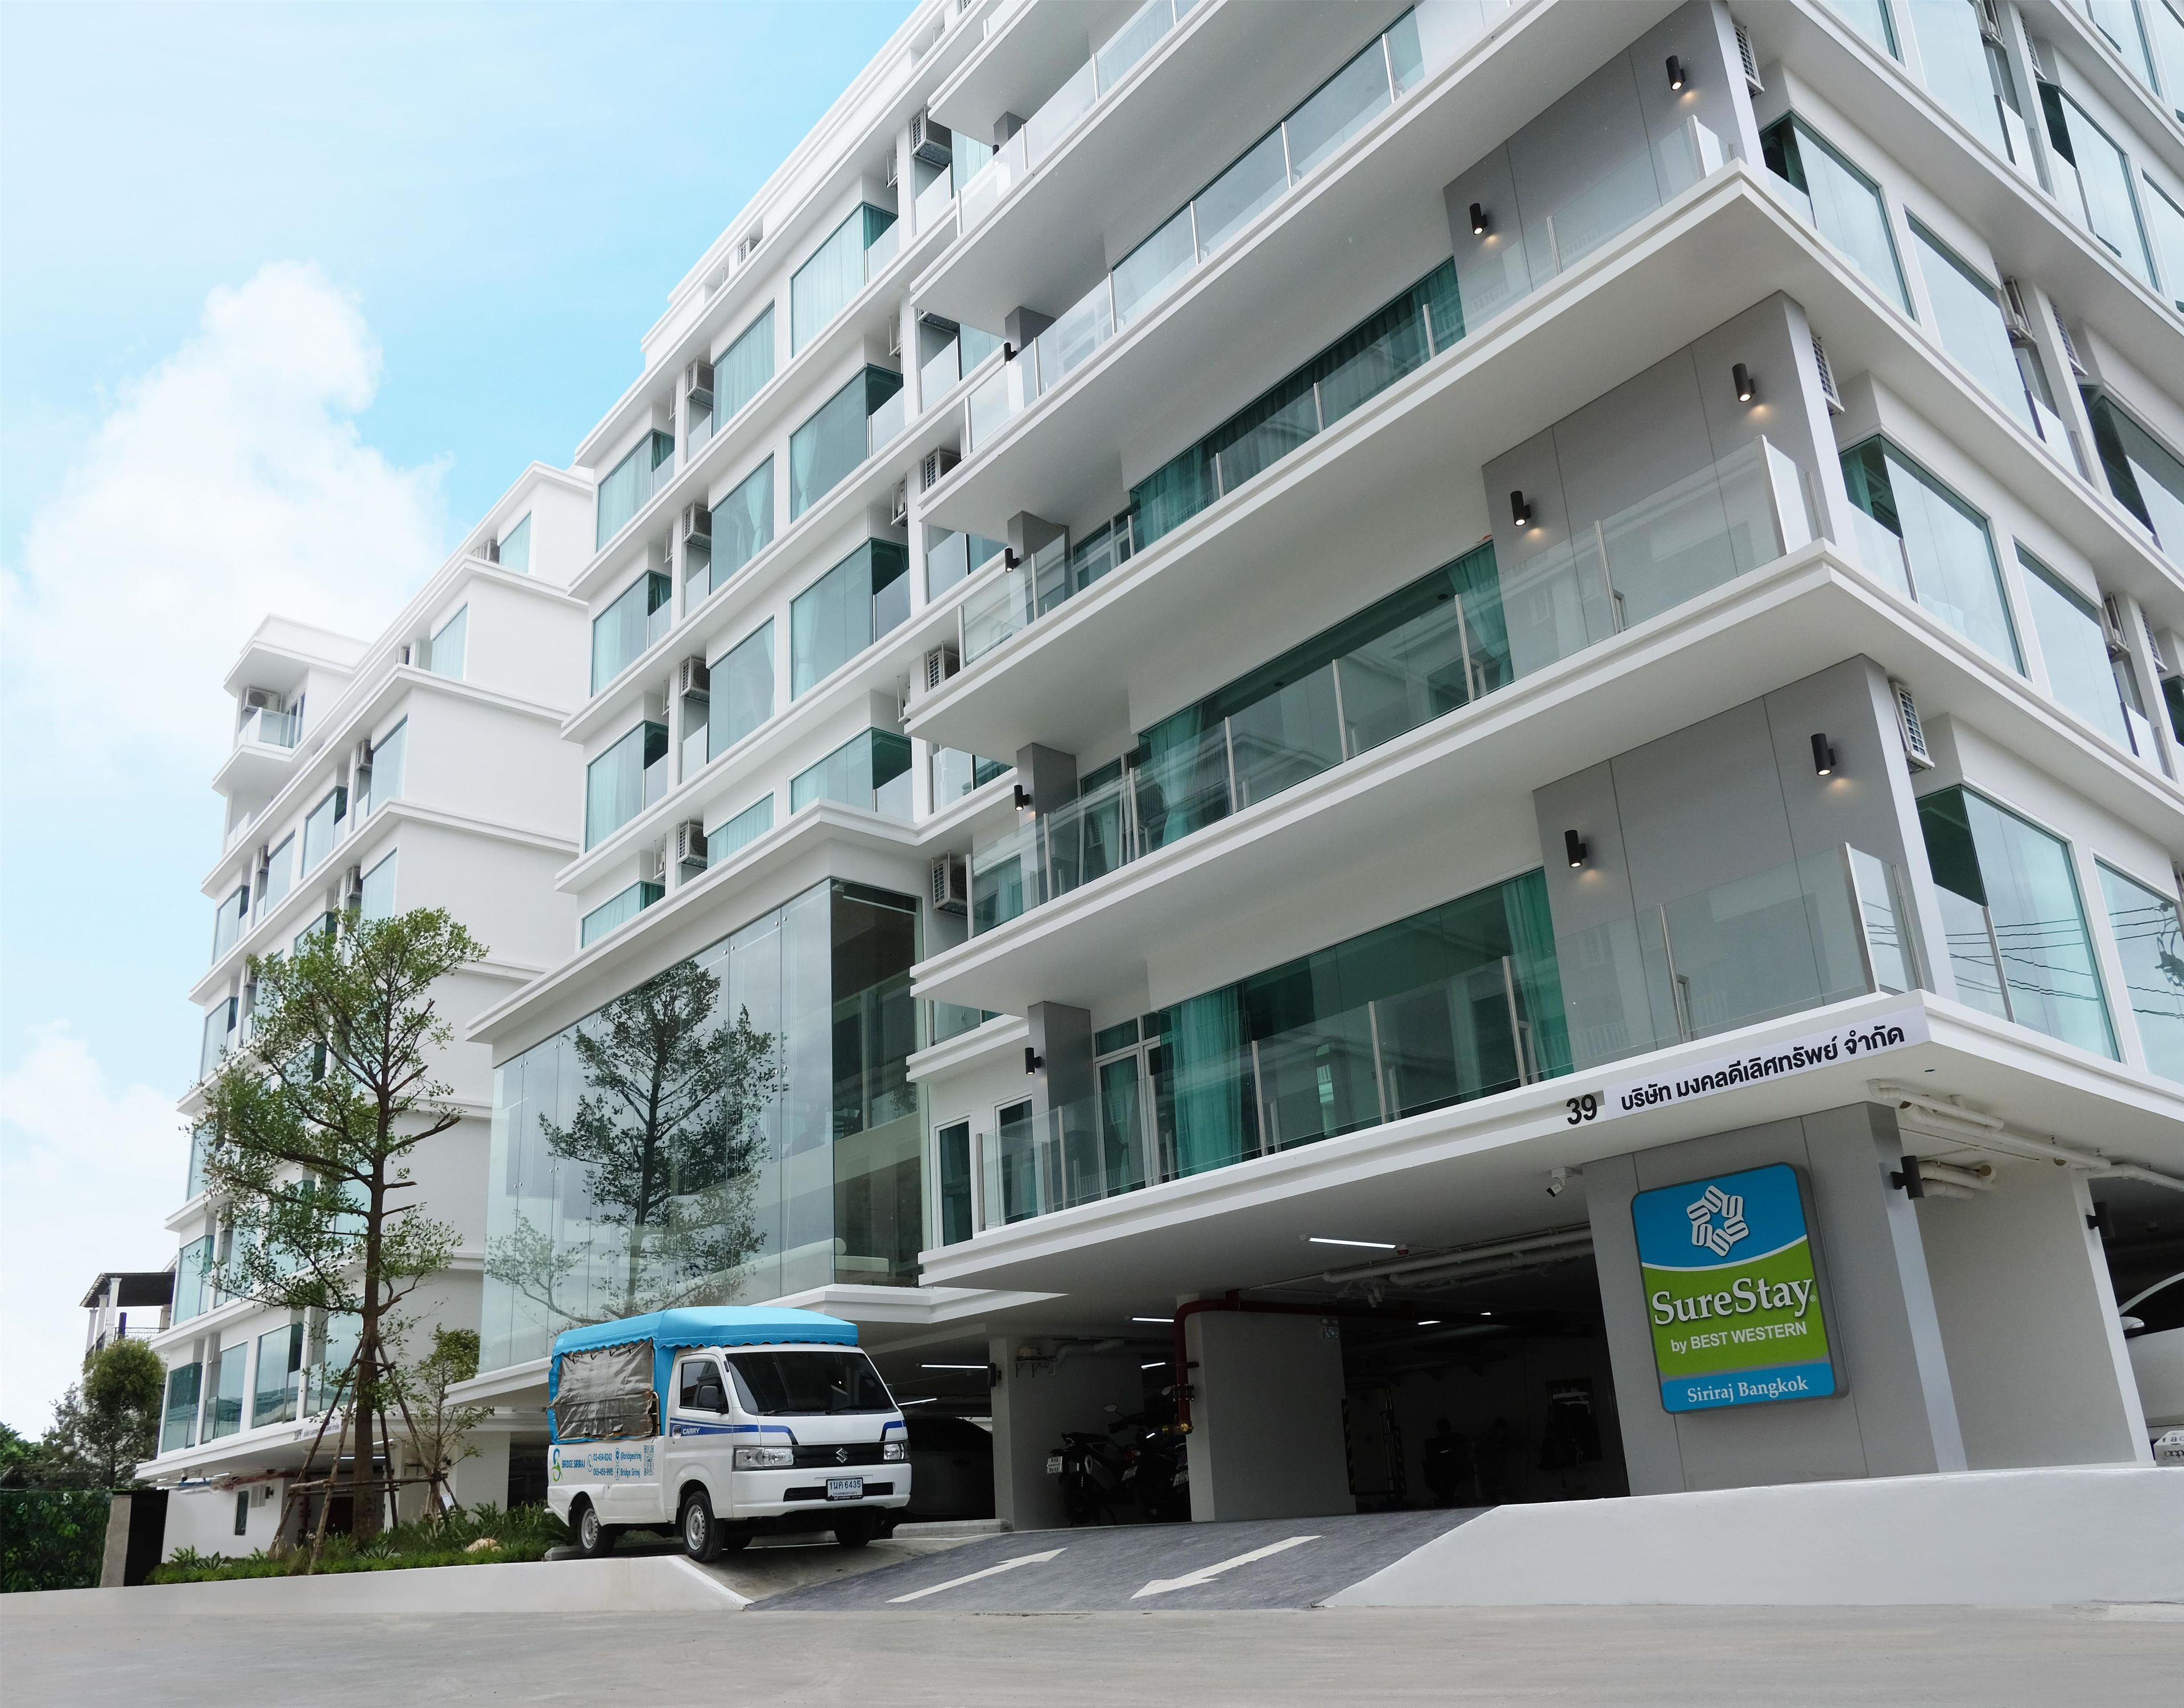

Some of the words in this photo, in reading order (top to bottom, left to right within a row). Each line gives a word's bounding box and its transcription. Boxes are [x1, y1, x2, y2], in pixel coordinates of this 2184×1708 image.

[1621, 1083, 1672, 1110] บริษัท
[1676, 1036, 1838, 1098] มงคลดีเลิศทรัพย์
[1844, 1025, 1905, 1054] จำกัด
[1566, 1094, 1598, 1125] 39
[1652, 1277, 1812, 1325] SureStay
[1670, 1339, 1687, 1354] by
[1690, 1331, 1728, 1349] BEST
[1731, 1321, 1807, 1343] WESTERN
[1687, 1383, 1734, 1403] Siriraj
[1738, 1375, 1809, 1398] Bangkok
[620, 1468, 631, 1478] Bridge
[845, 1480, 861, 1488] 6435
